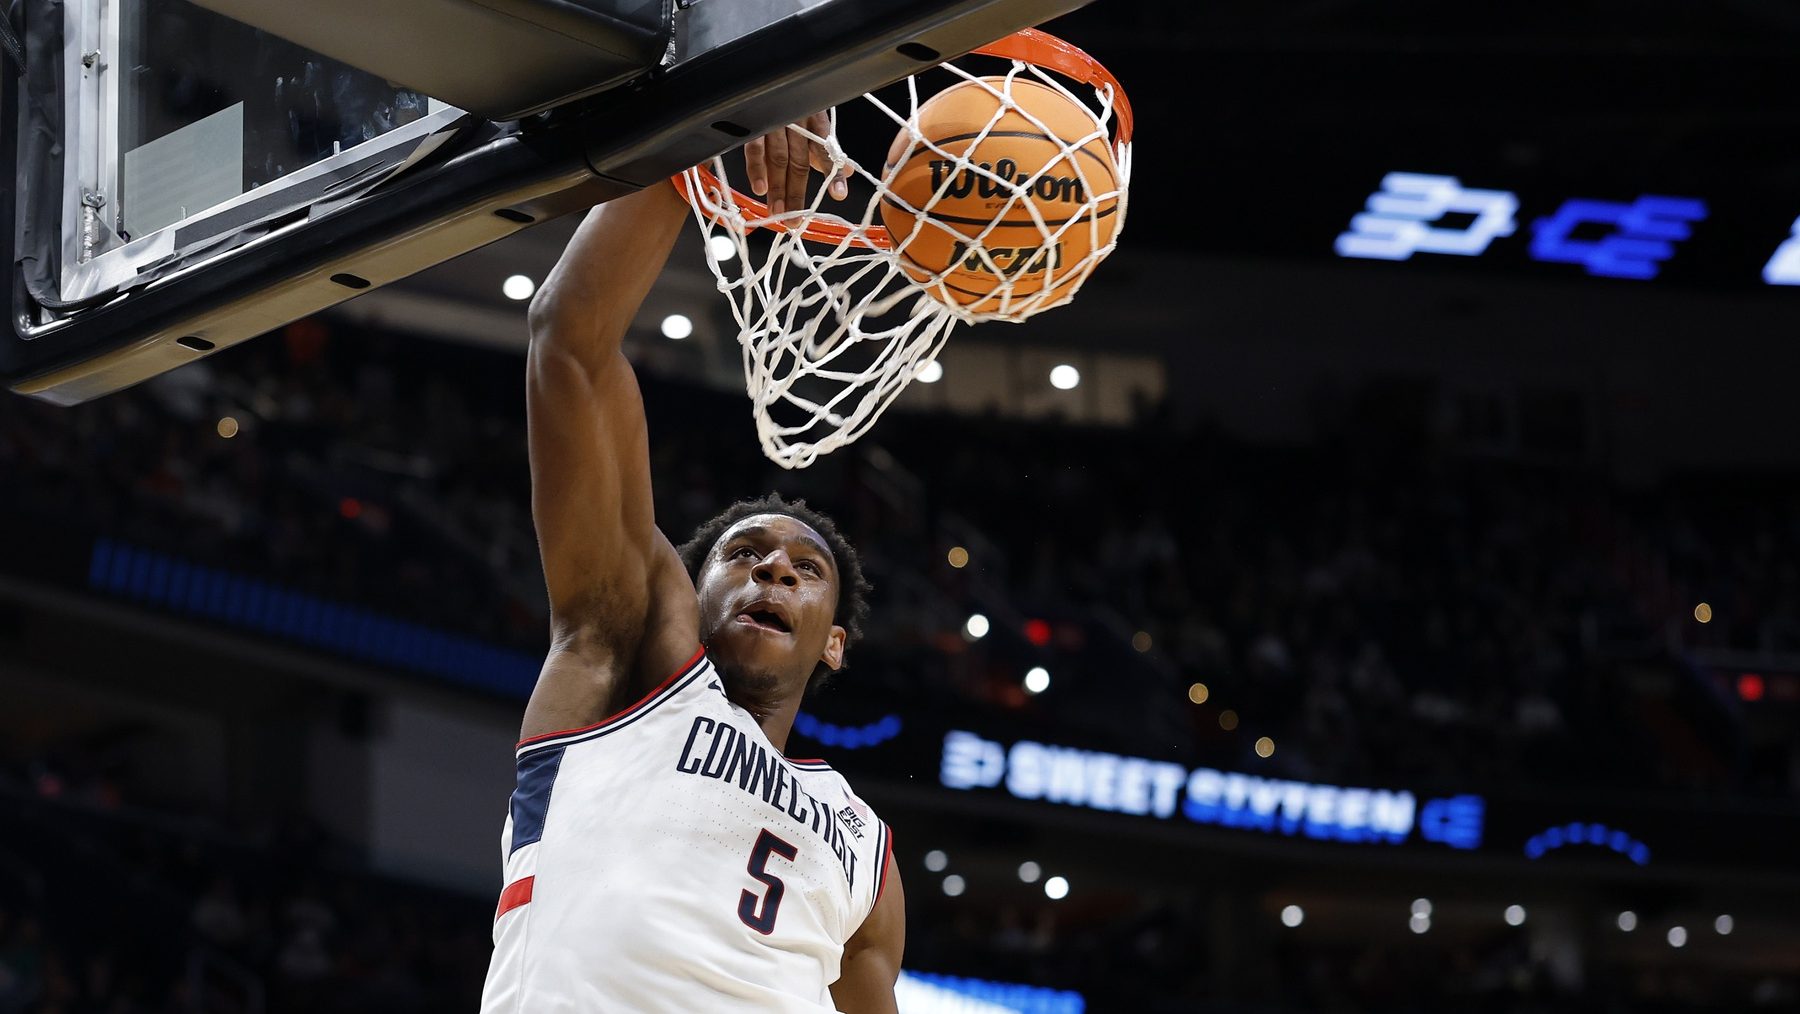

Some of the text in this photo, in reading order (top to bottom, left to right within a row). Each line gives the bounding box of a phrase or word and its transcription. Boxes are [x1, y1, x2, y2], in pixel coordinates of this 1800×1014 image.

[928, 158, 1086, 204] Wilson
[676, 715, 858, 899] CONNECTICUT
[839, 809, 865, 839] EAST
[844, 806, 866, 828] BIG
[1006, 740, 1416, 844] SWEET SIXTEEN
[737, 827, 798, 936] 5
